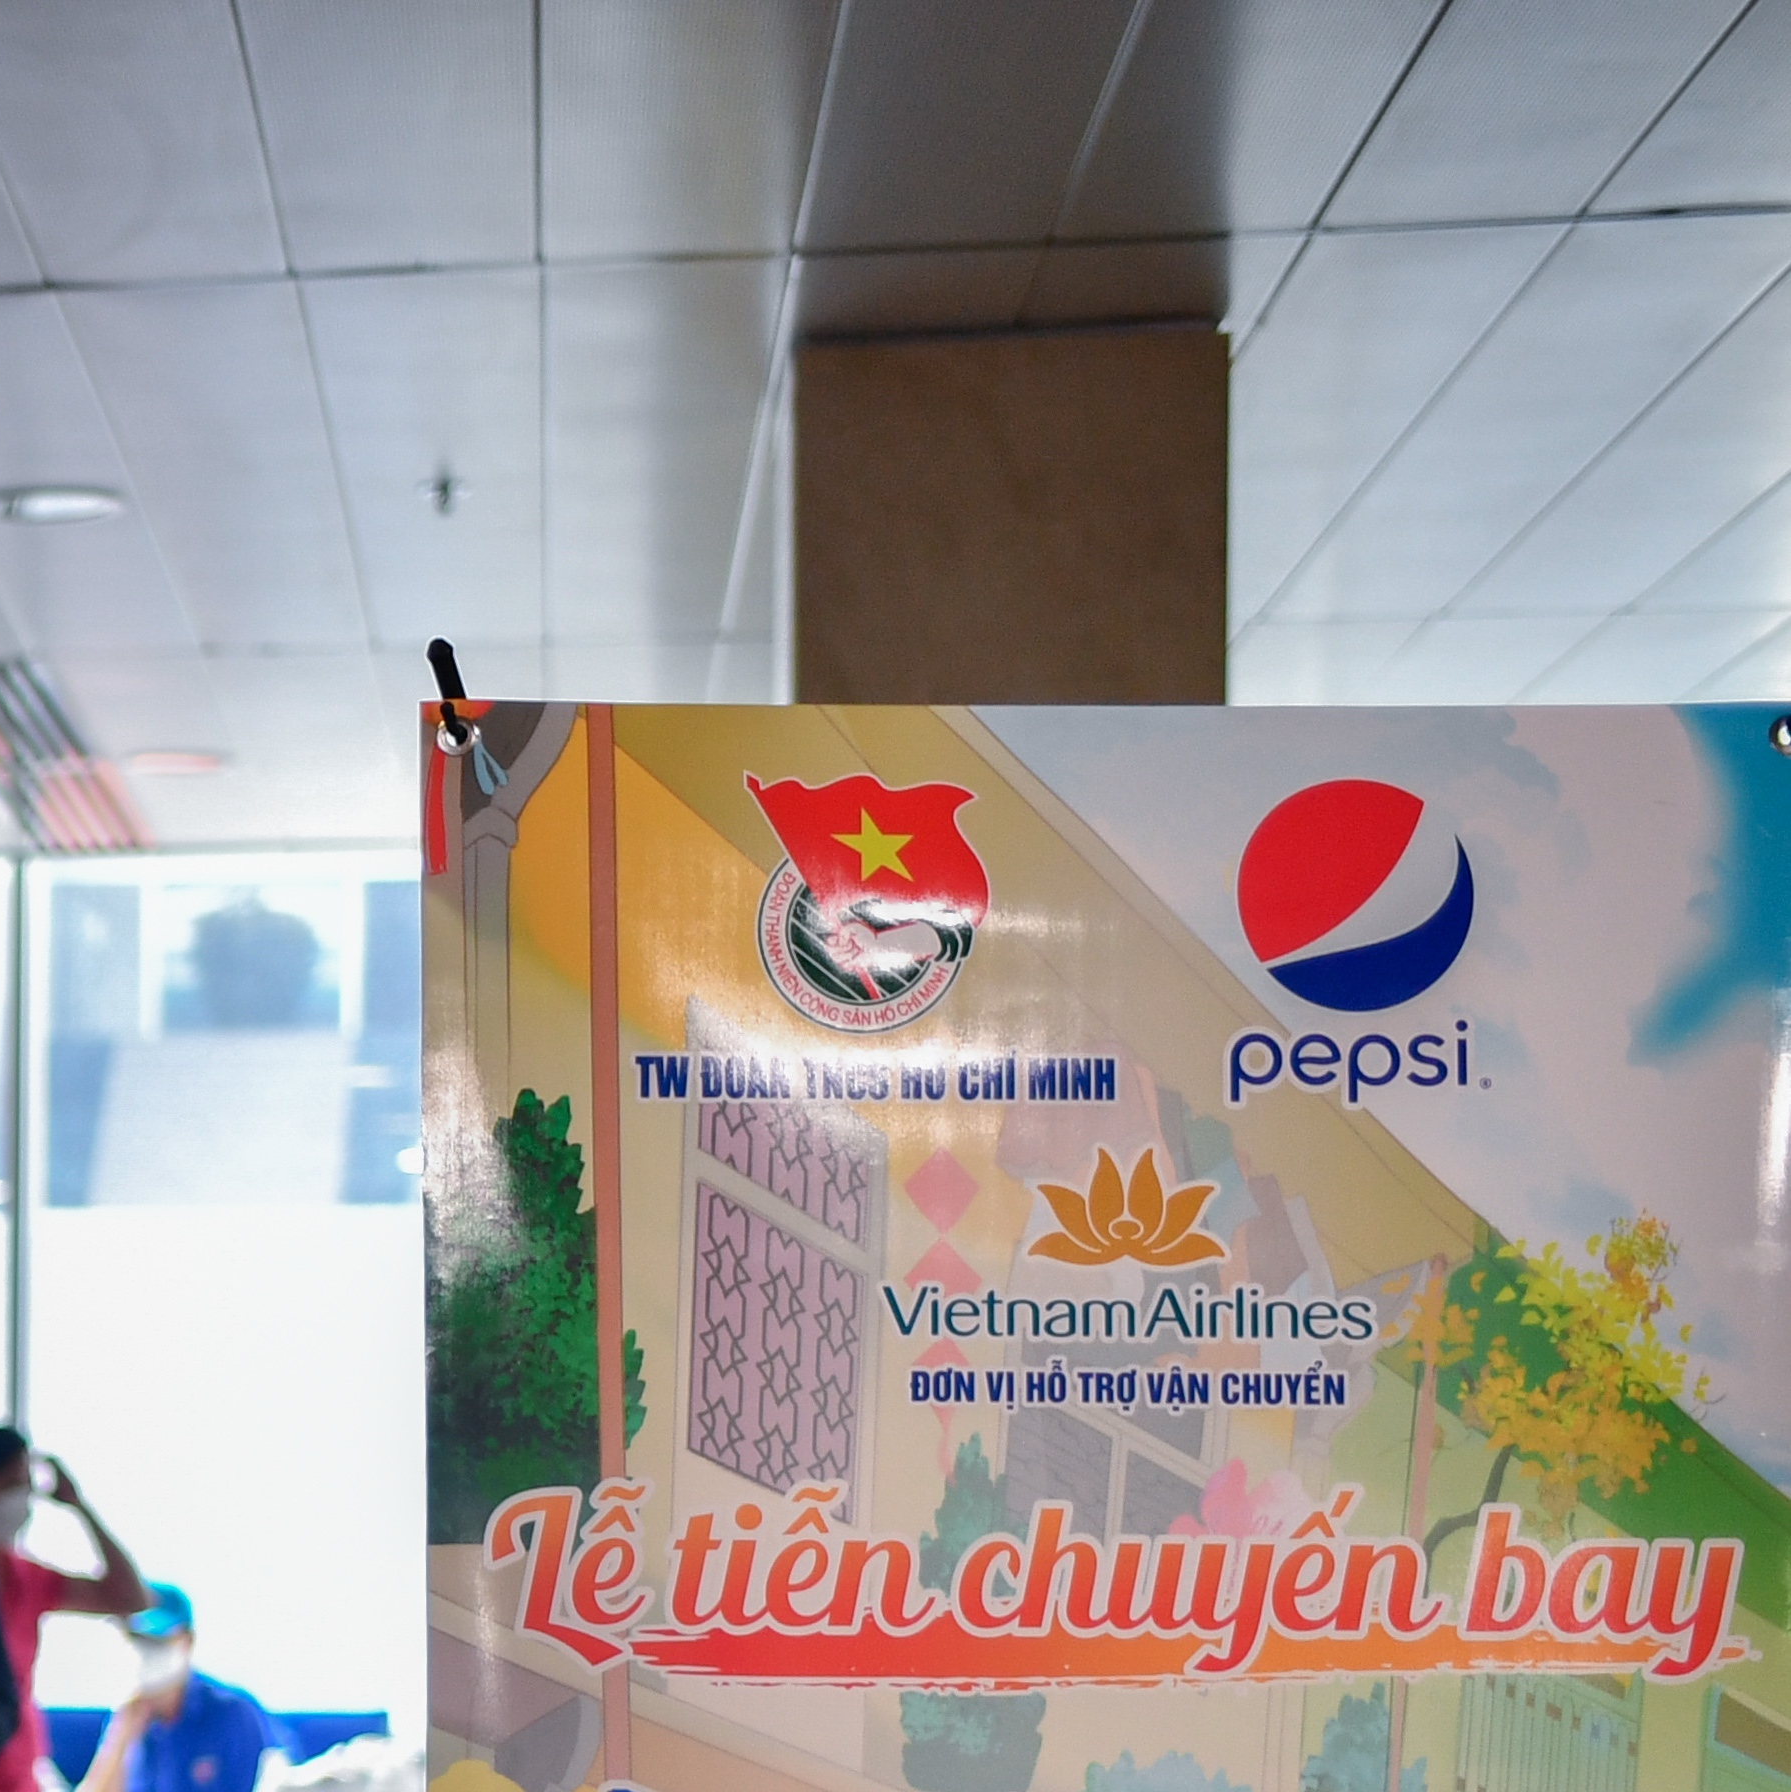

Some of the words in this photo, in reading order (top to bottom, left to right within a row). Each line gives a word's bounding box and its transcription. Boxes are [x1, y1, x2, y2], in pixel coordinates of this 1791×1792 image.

[918, 965, 950, 1003] MINH
[635, 1056, 690, 1098] TW
[1028, 1057, 1115, 1101] MINH
[1230, 1020, 1468, 1103] pepsi
[882, 1286, 1137, 1338] Vietnam
[1145, 1287, 1373, 1341] Airlines
[910, 1369, 975, 1403] ĐƠN
[984, 1370, 1015, 1410] VỊ
[1026, 1359, 1067, 1403] HỖ
[1078, 1371, 1137, 1414] TRỢ
[1147, 1366, 1209, 1411] VẬN
[1221, 1361, 1345, 1406] CHUYỂN
[492, 1484, 647, 1667] Lễ
[672, 1486, 937, 1628] tiễn
[958, 1490, 1443, 1673] chuyến
[1466, 1511, 1736, 1677] bay
